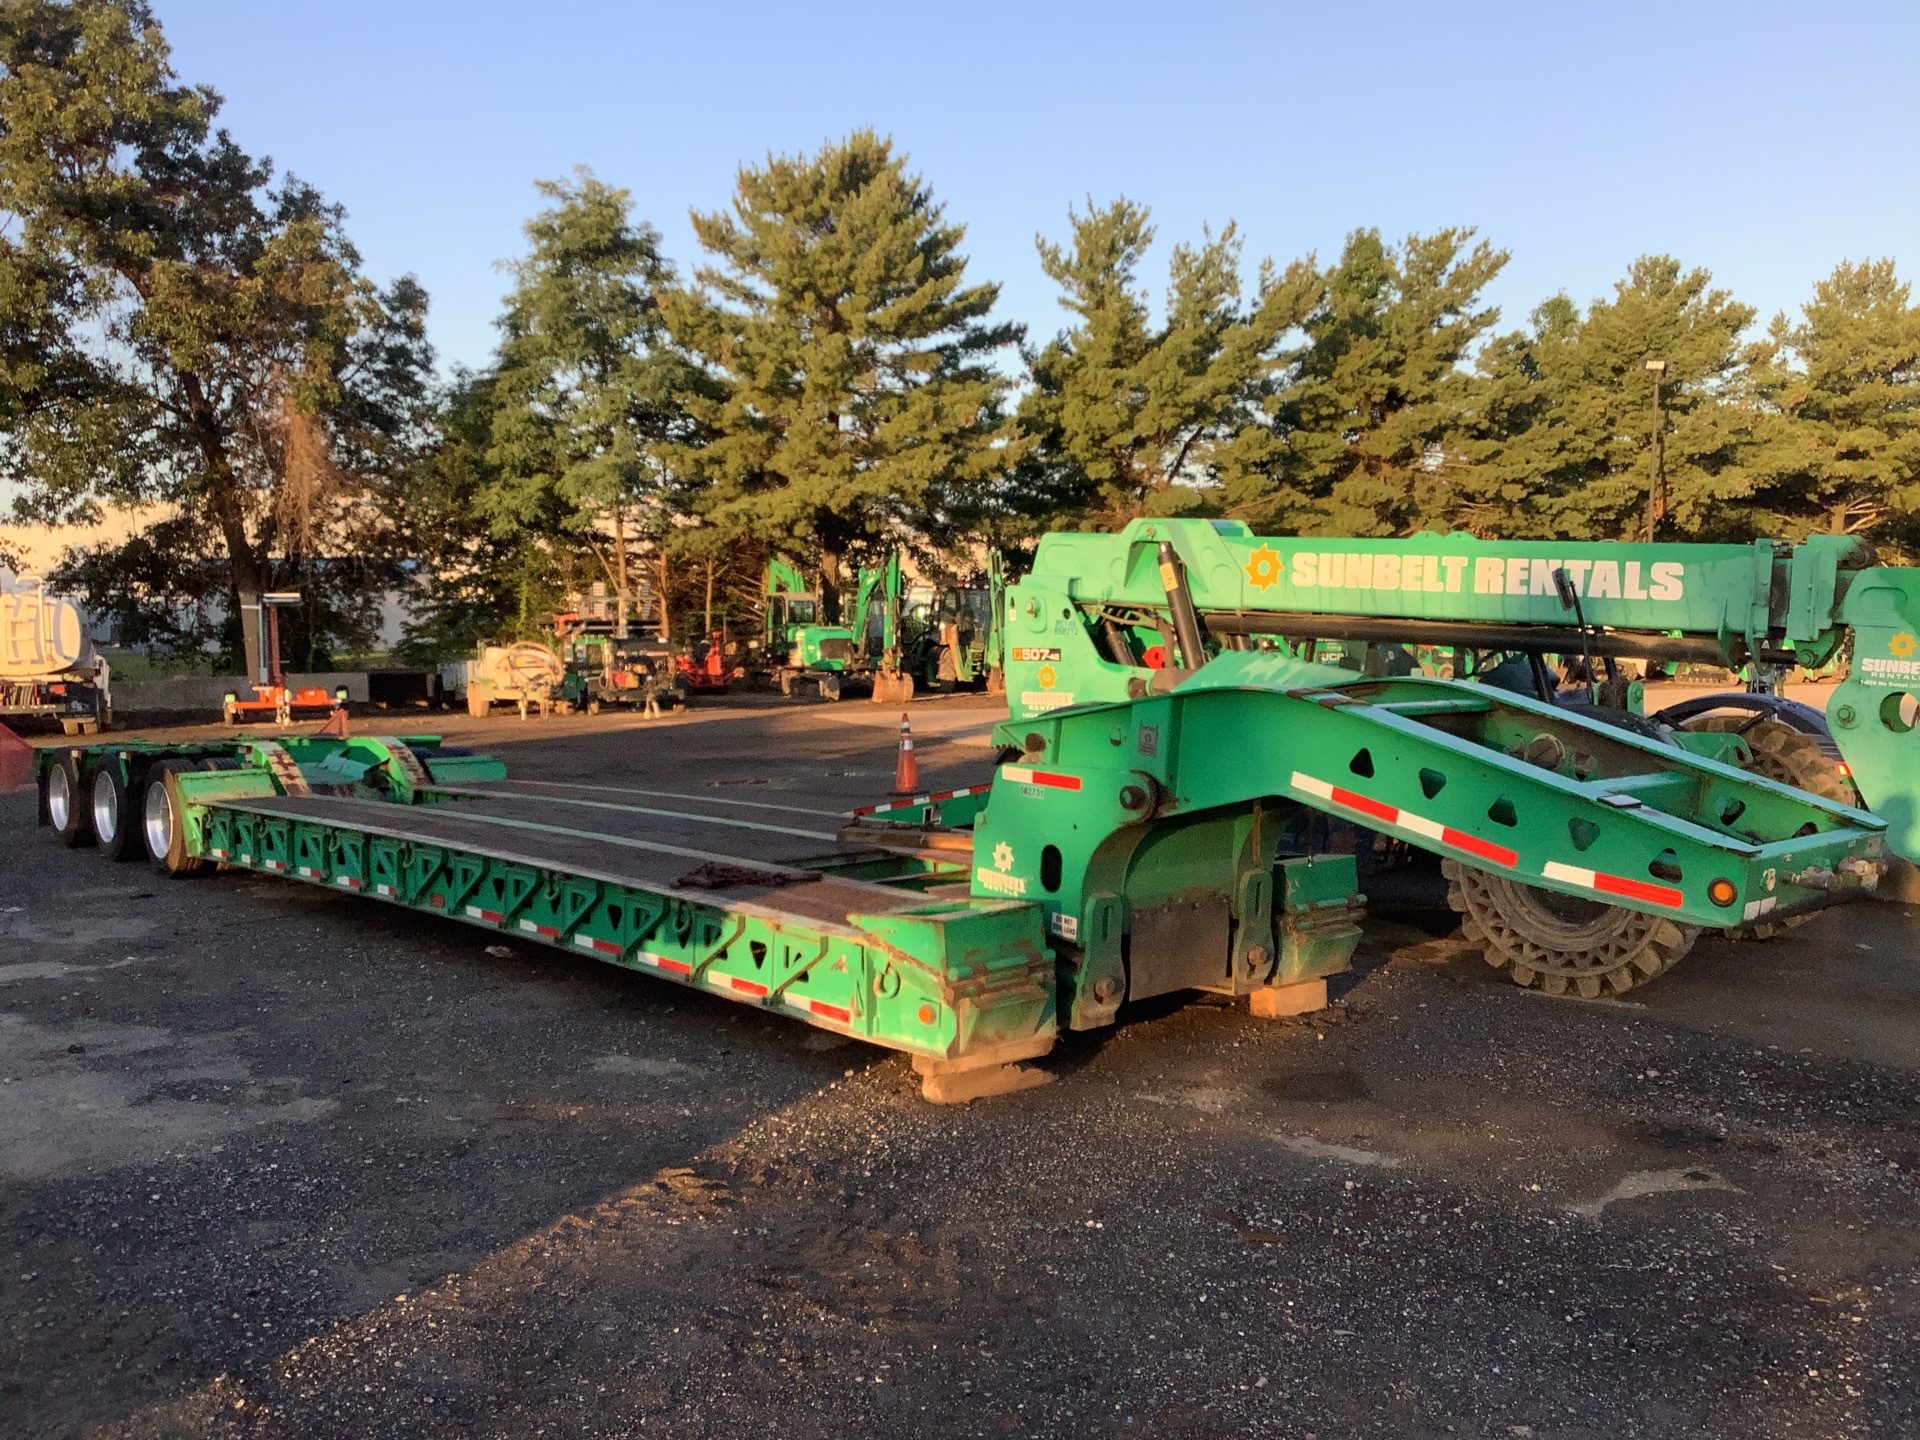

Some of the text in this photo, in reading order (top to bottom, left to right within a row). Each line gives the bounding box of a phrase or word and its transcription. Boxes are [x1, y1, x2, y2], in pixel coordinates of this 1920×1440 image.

[1292, 552, 1684, 601] SUNBELT RENTALS
[1871, 672, 1920, 681] RENTAL
